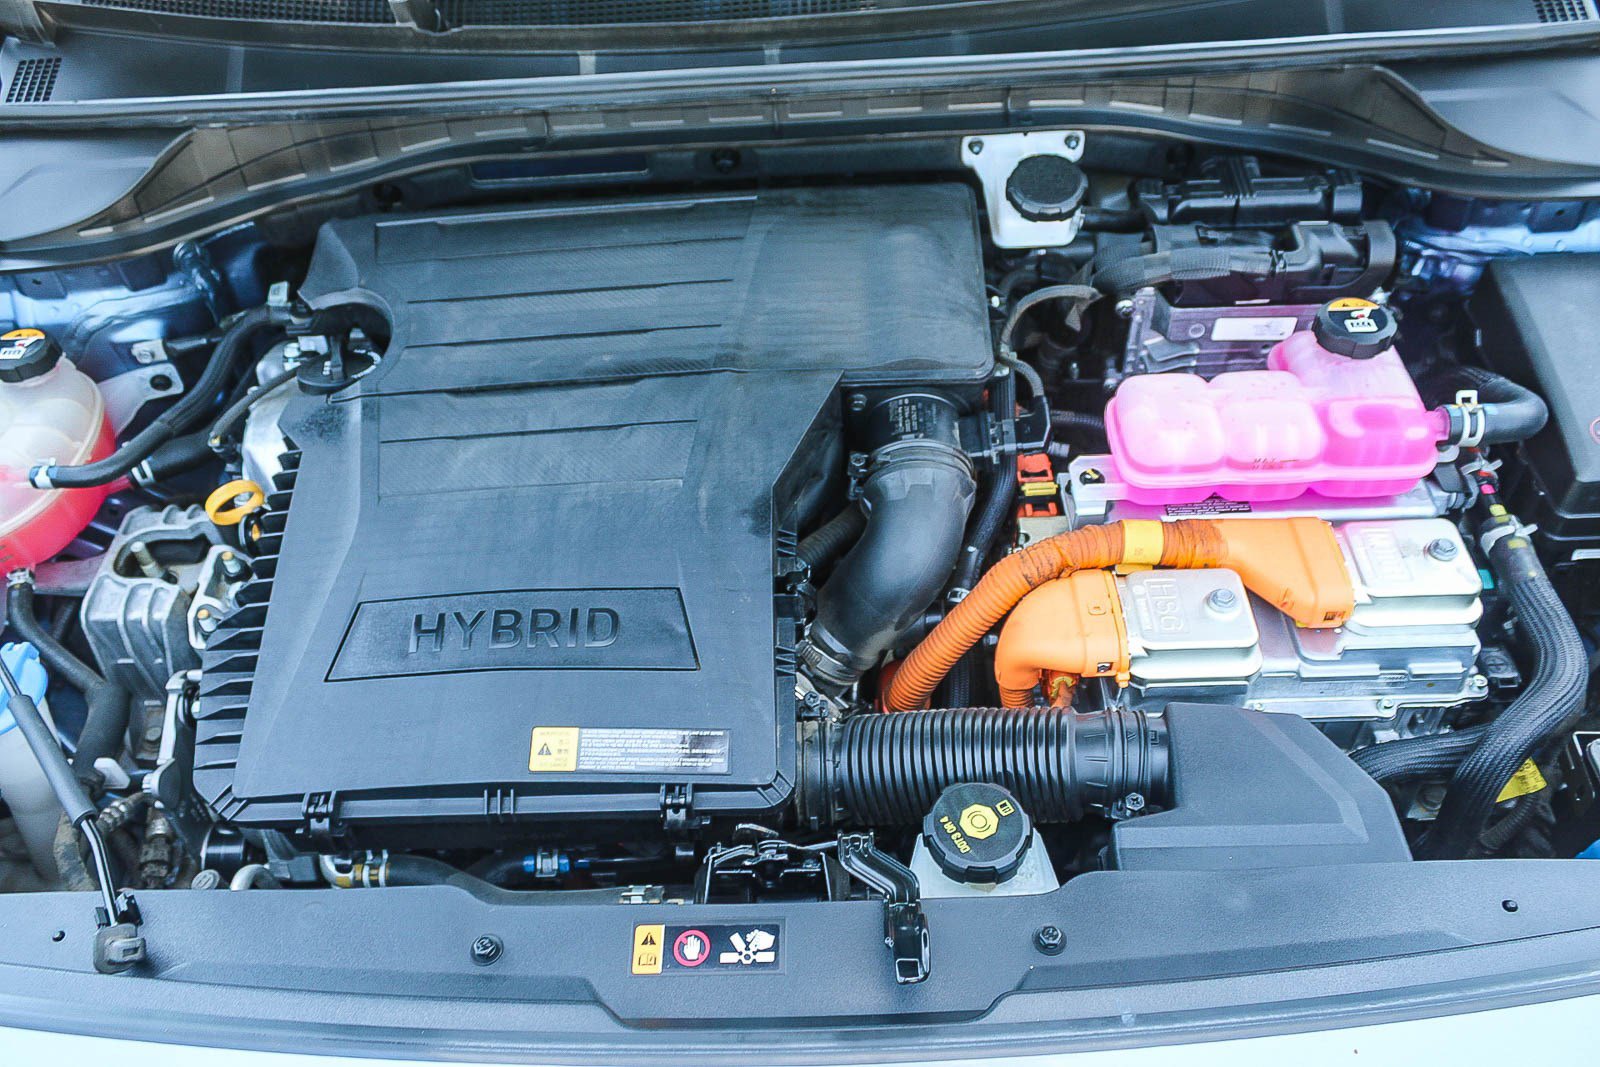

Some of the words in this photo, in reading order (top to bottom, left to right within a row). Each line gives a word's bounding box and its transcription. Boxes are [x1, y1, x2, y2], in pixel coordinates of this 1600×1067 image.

[408, 607, 619, 653] HYBRID
[1150, 584, 1184, 631] HSG
[943, 821, 957, 833] OR
